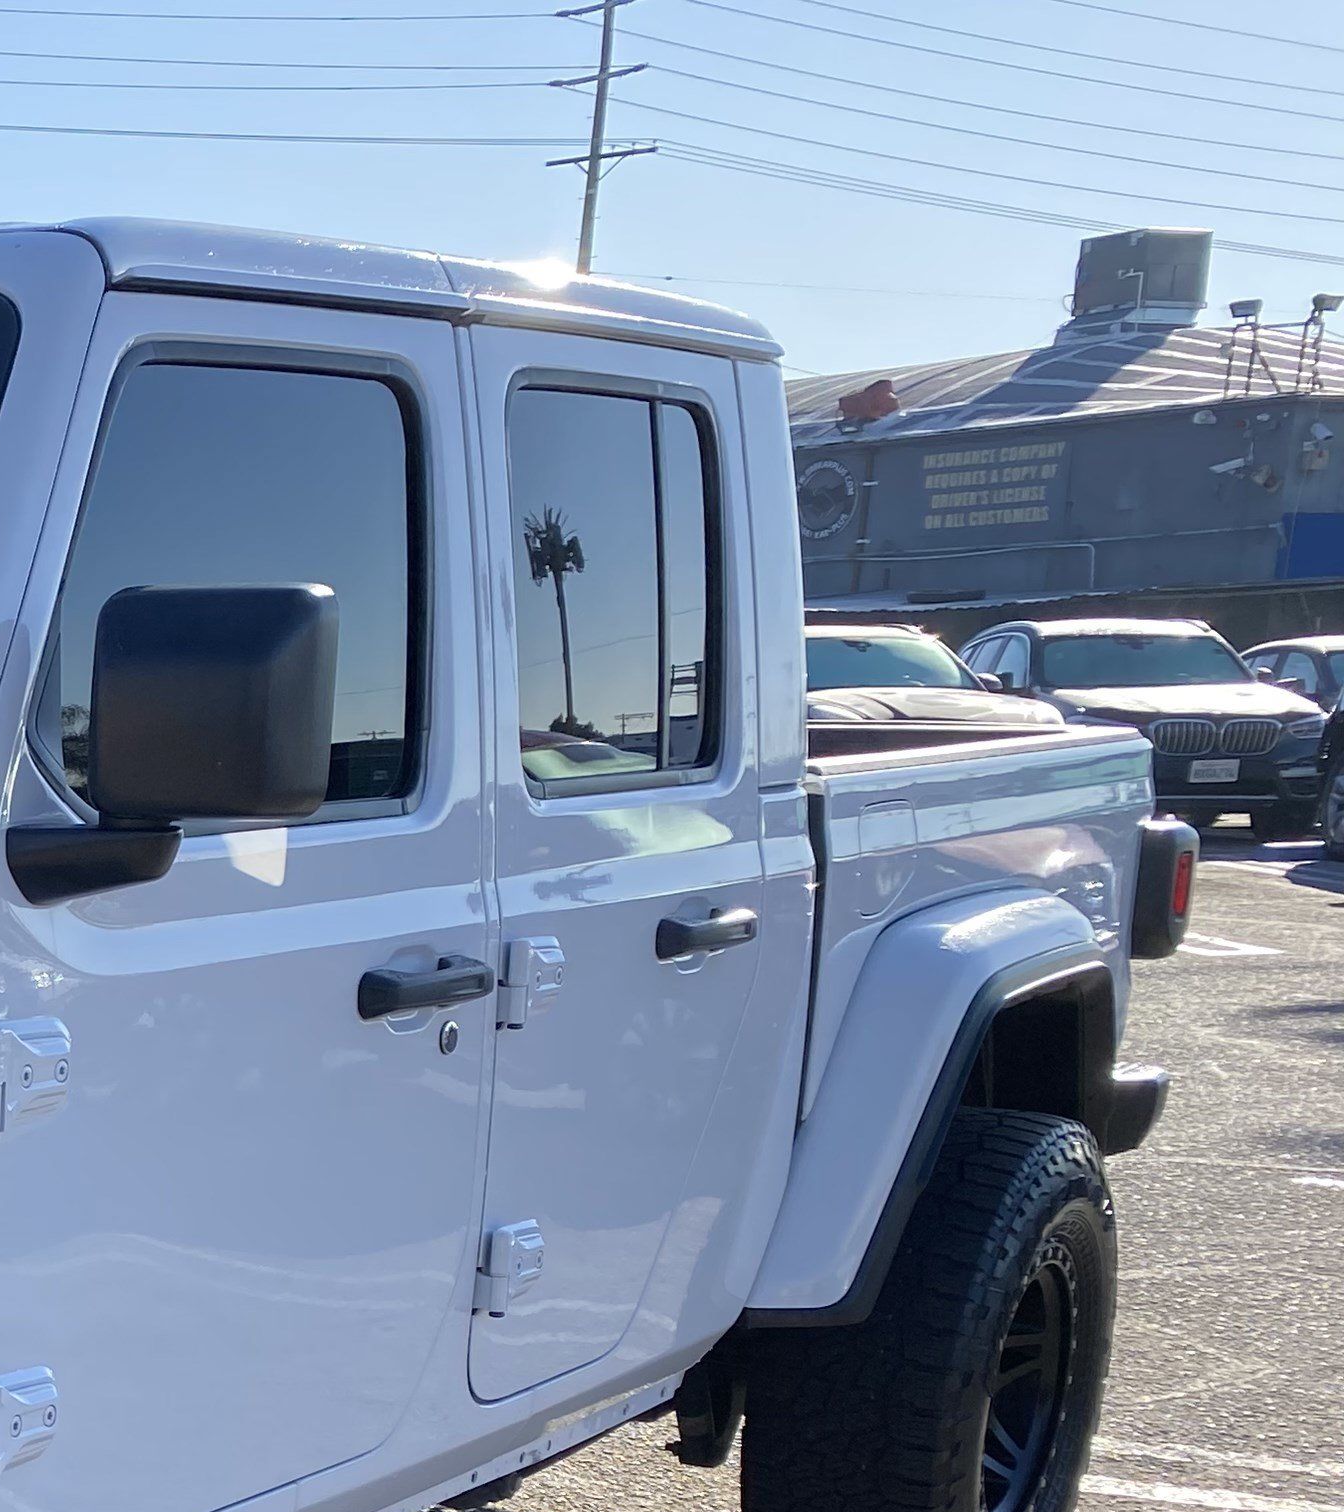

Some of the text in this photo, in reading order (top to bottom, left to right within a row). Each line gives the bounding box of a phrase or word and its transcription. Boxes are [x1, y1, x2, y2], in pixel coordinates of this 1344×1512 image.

[923, 441, 1066, 469] INSURANCE COMPANY
[925, 463, 1058, 489] REQUIRES A COPY OF
[993, 486, 1048, 504] LICENSE
[944, 512, 965, 528] ALL
[968, 506, 1050, 527] CUSTOMERS
